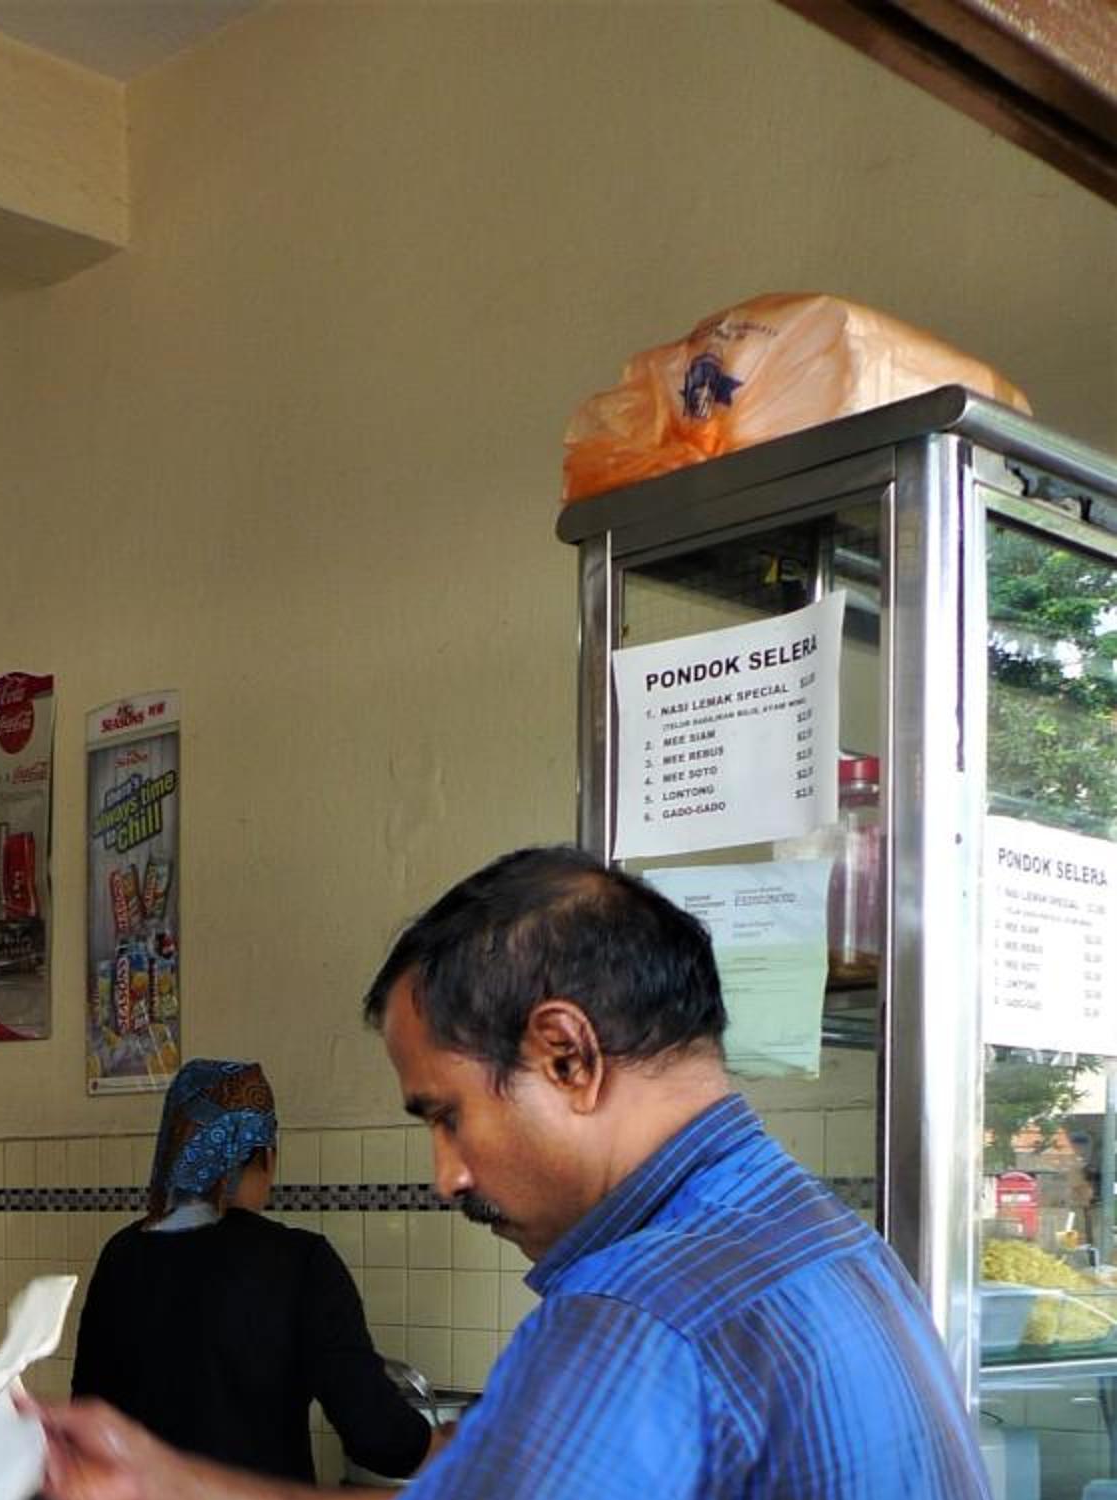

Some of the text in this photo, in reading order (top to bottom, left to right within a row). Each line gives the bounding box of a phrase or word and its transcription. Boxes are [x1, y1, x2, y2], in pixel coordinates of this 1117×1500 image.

[646, 634, 818, 691] PONDOK SELERA
[660, 704, 688, 717] NASI
[692, 694, 733, 711] LEMAK
[736, 683, 790, 702] SPECIAL
[689, 730, 716, 743] SIAM
[141, 772, 174, 803] time
[689, 766, 718, 779] SOTO
[662, 784, 714, 802] LONTONG
[662, 801, 726, 820] GADO-GADO
[117, 801, 162, 852] chill
[998, 847, 1108, 887] PONDOK SELERA
